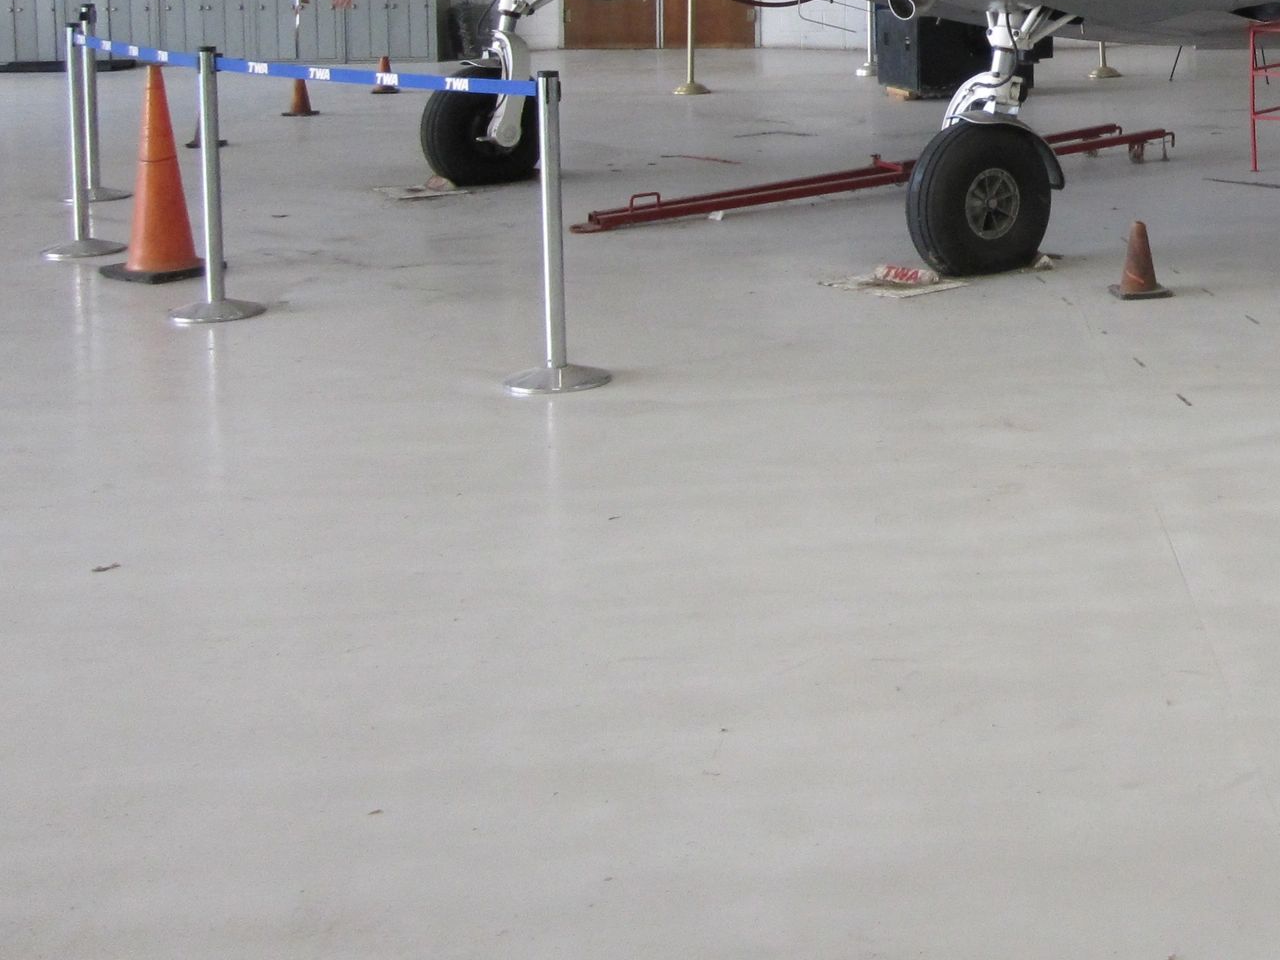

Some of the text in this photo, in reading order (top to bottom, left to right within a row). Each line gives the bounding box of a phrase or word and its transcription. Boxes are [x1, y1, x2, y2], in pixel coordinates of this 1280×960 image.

[247, 61, 269, 75] TWA
[308, 67, 331, 81] TWA
[375, 72, 398, 86] TWA
[445, 77, 470, 91] TWA
[885, 266, 919, 283] TWA
